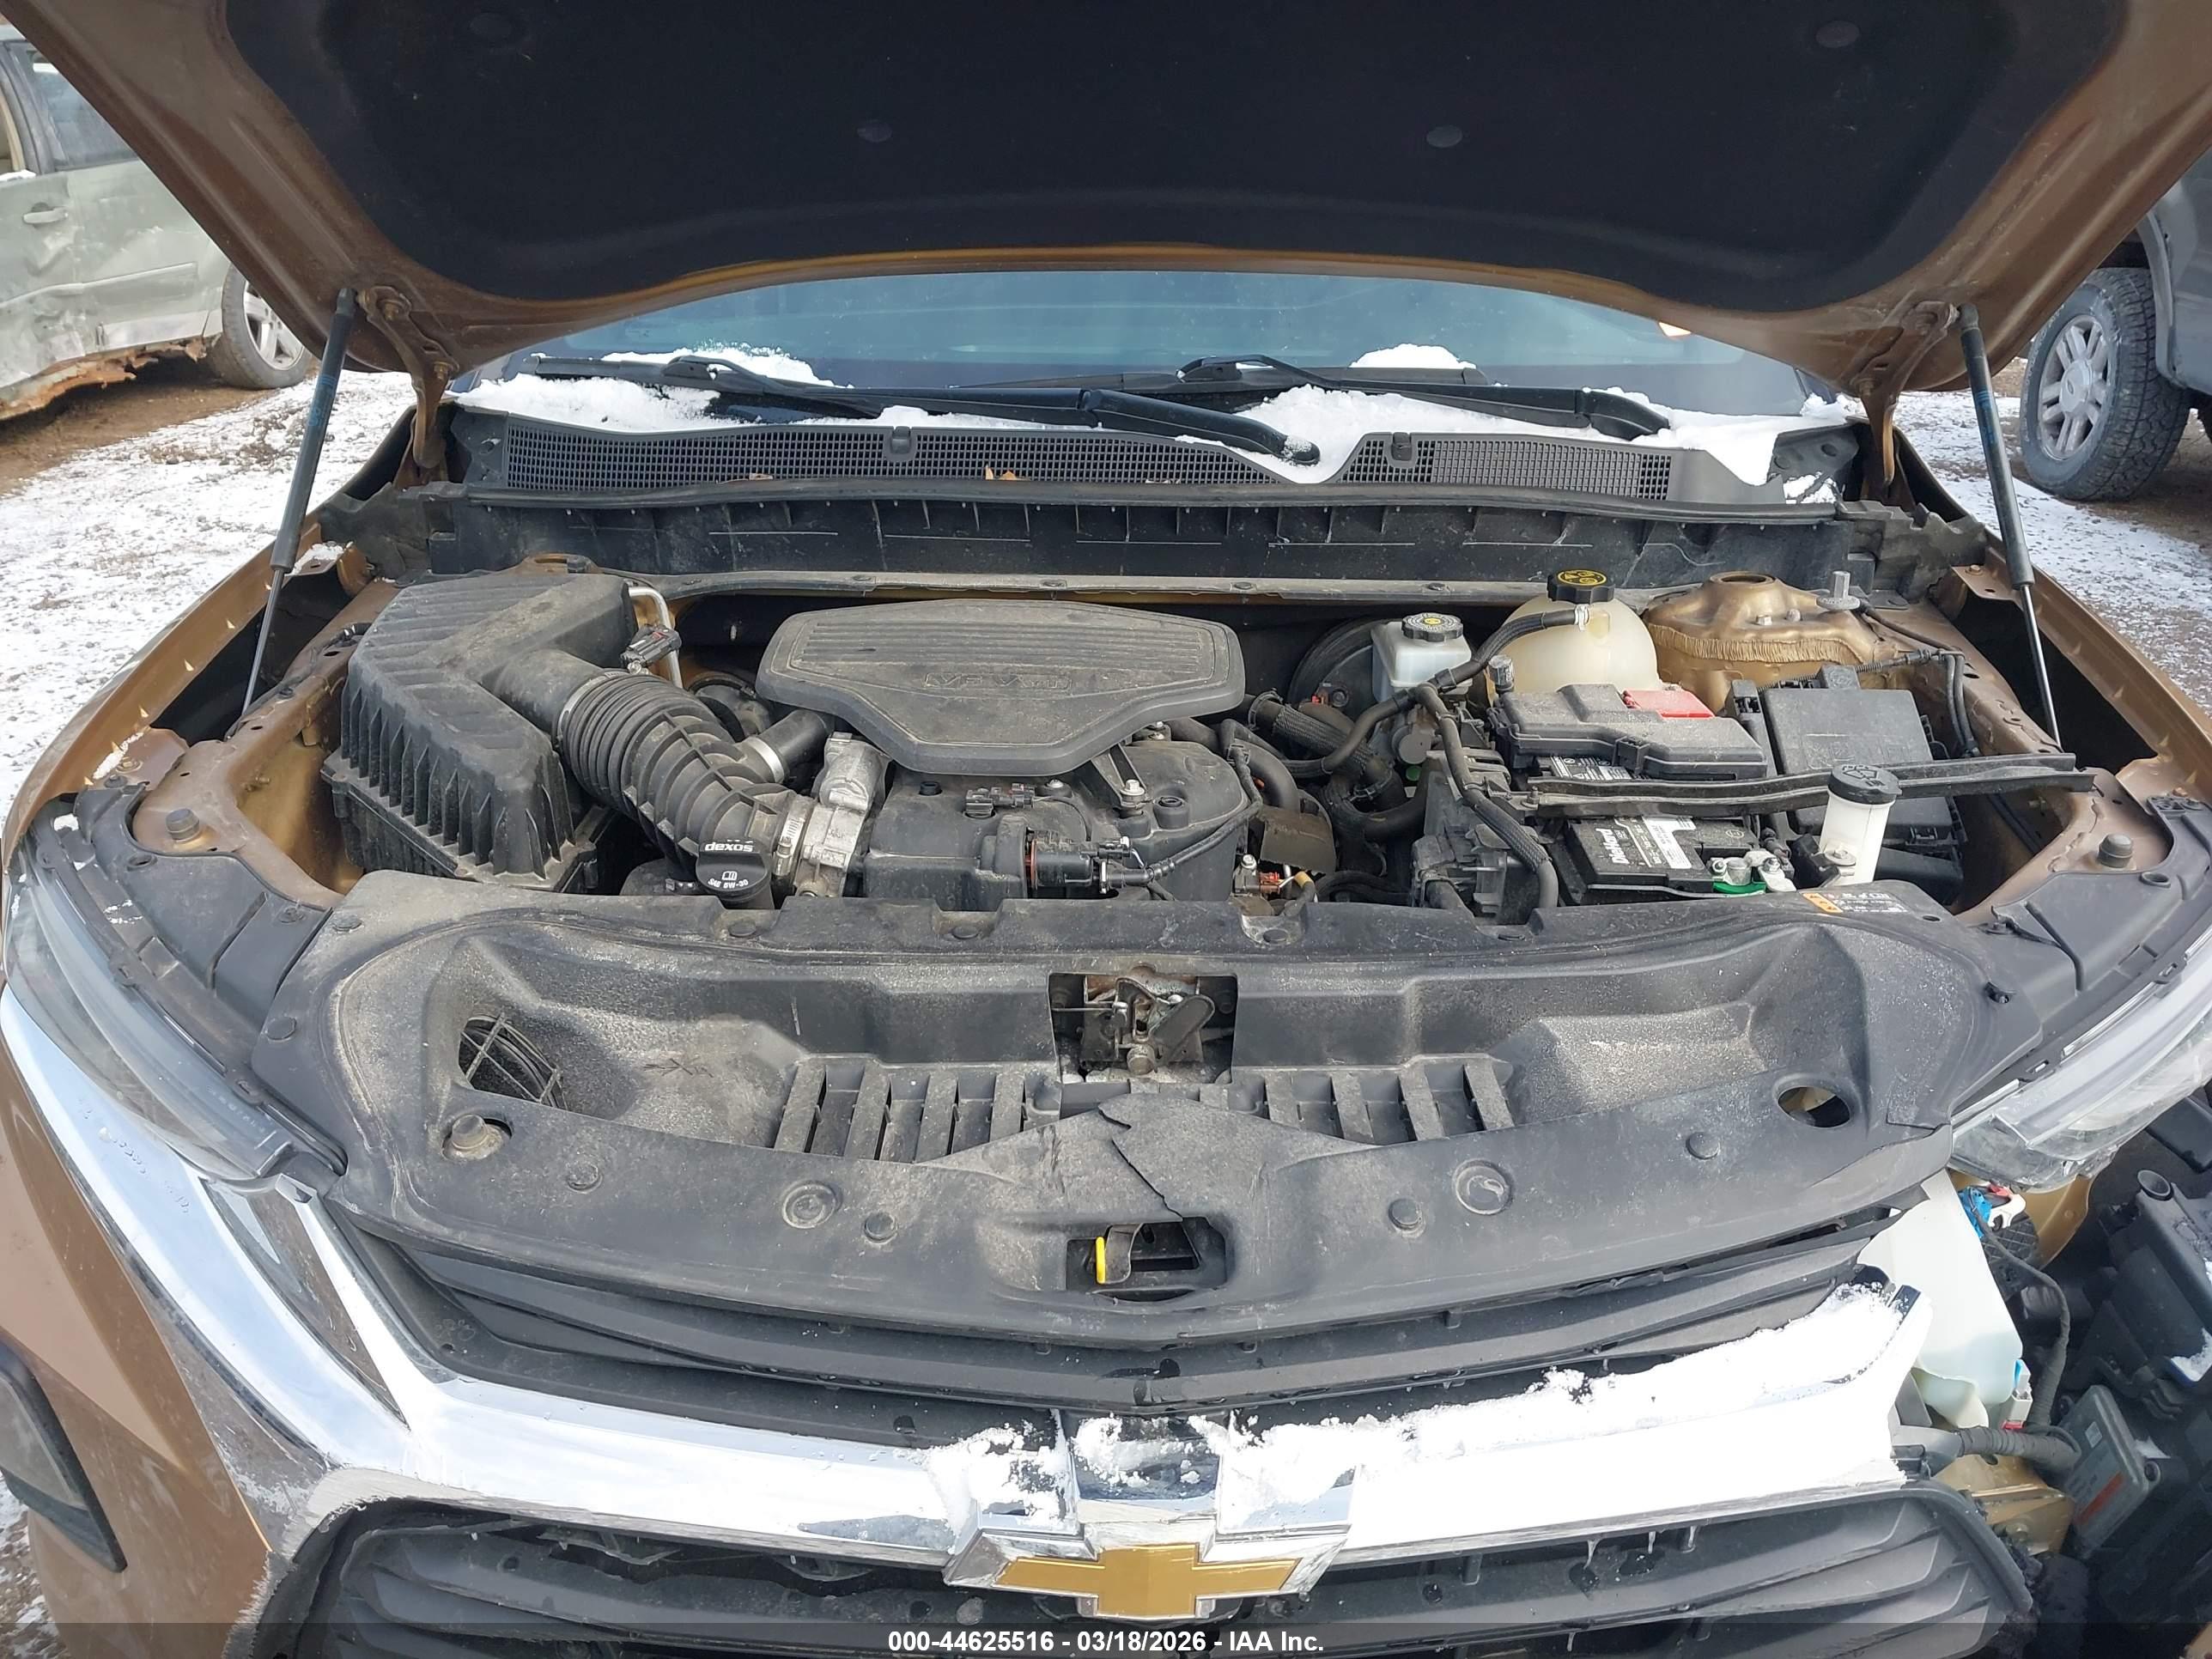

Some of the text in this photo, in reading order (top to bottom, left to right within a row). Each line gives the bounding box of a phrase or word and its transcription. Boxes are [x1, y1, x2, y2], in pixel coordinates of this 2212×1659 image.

[704, 842, 754, 853] dexos
[1595, 828, 1630, 864] DieHard
[708, 878, 749, 889] SAE 5W-30
